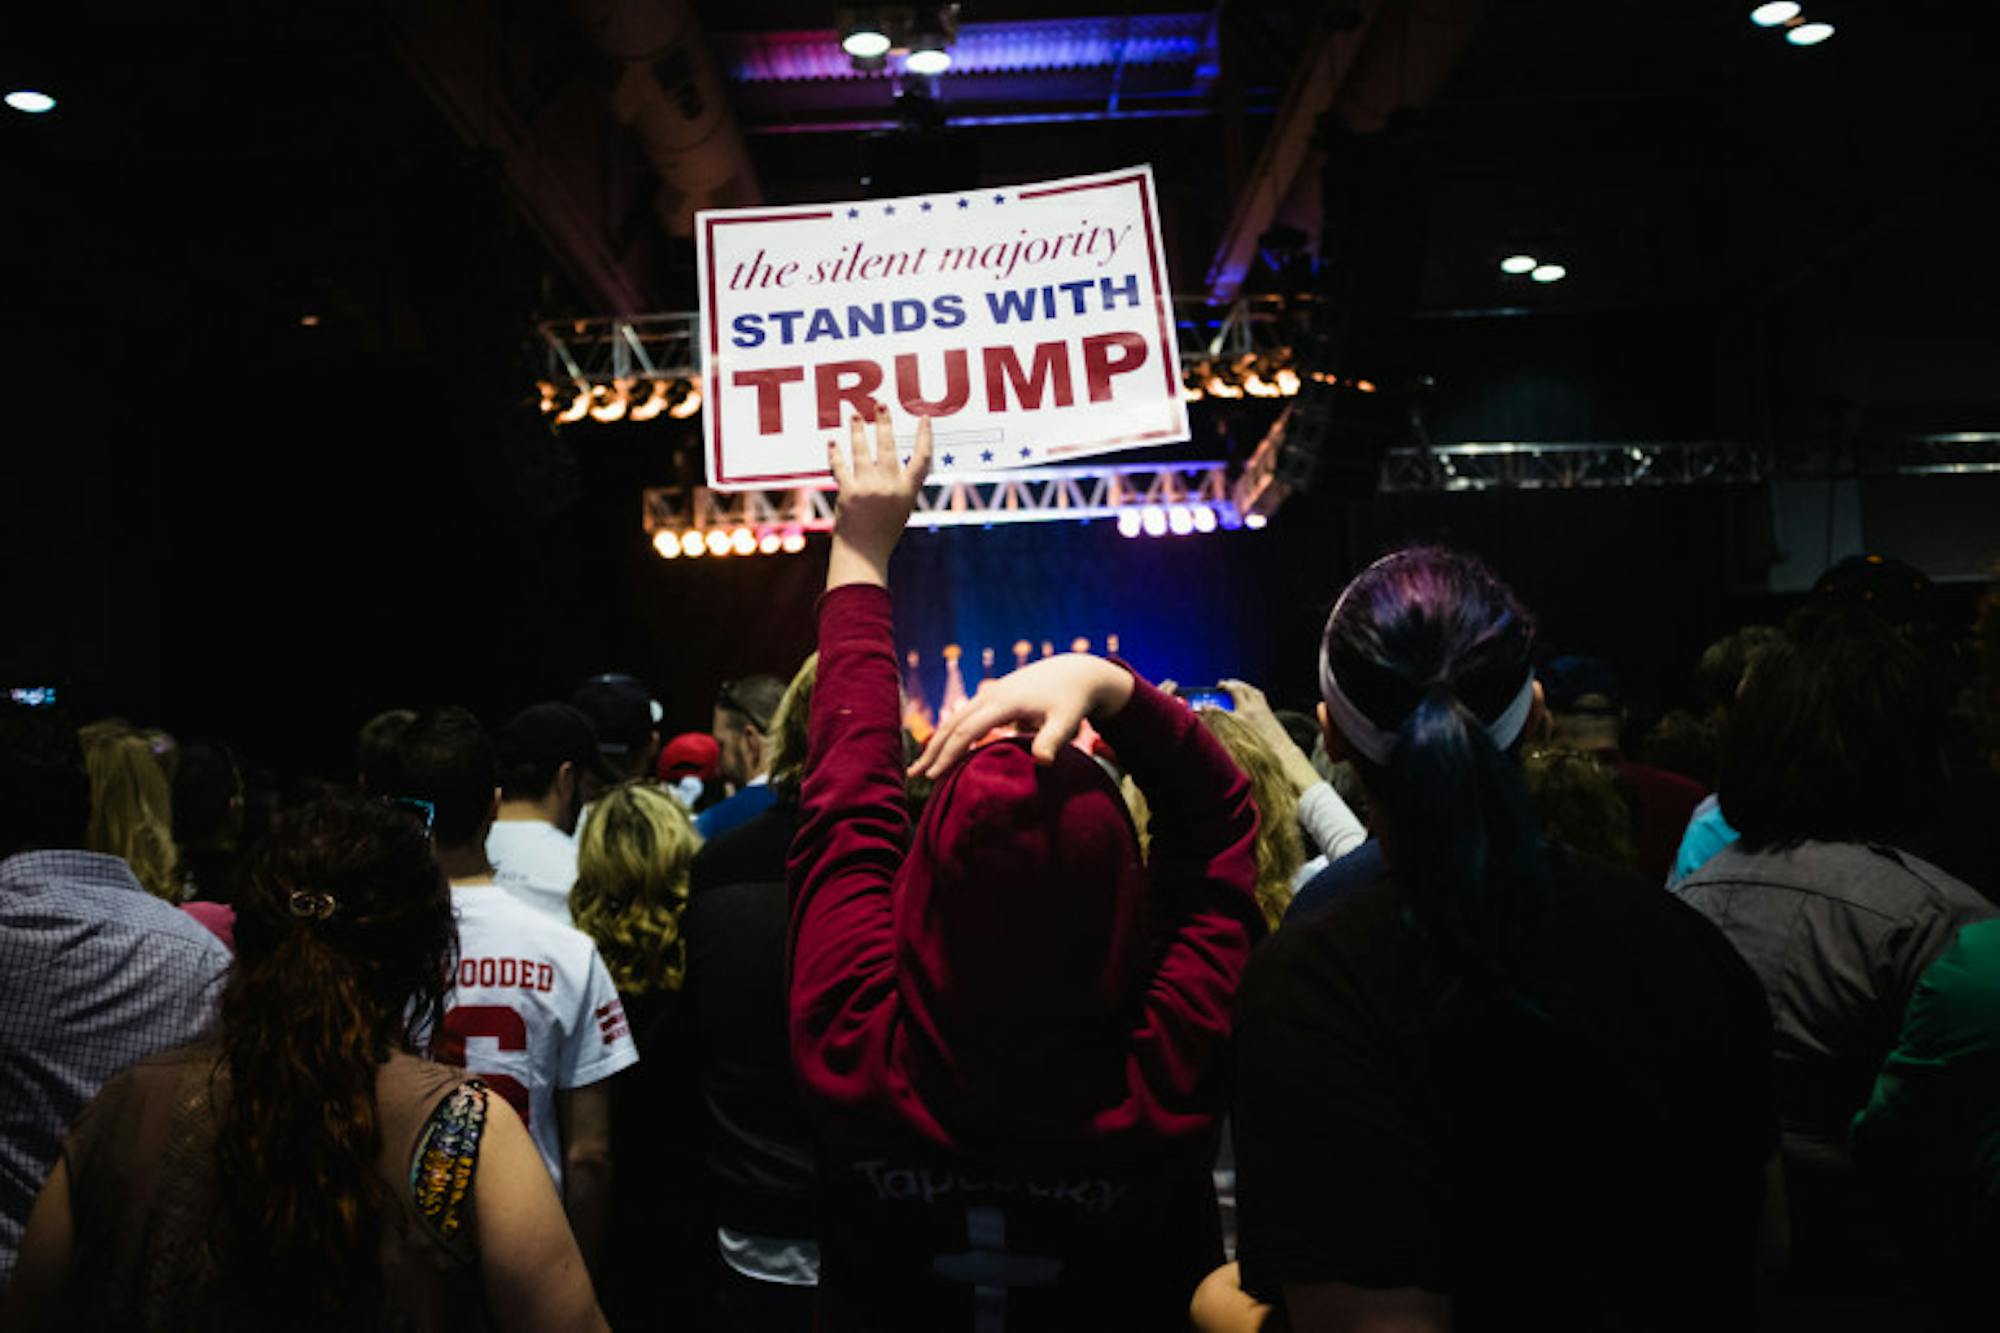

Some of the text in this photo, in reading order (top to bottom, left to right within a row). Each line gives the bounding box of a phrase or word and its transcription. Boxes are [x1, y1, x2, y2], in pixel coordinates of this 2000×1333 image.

[729, 219, 1132, 291] the silent majority
[732, 274, 1140, 348] STANDS WITH
[732, 331, 1149, 436] TRUMP
[441, 957, 554, 992] OODED
